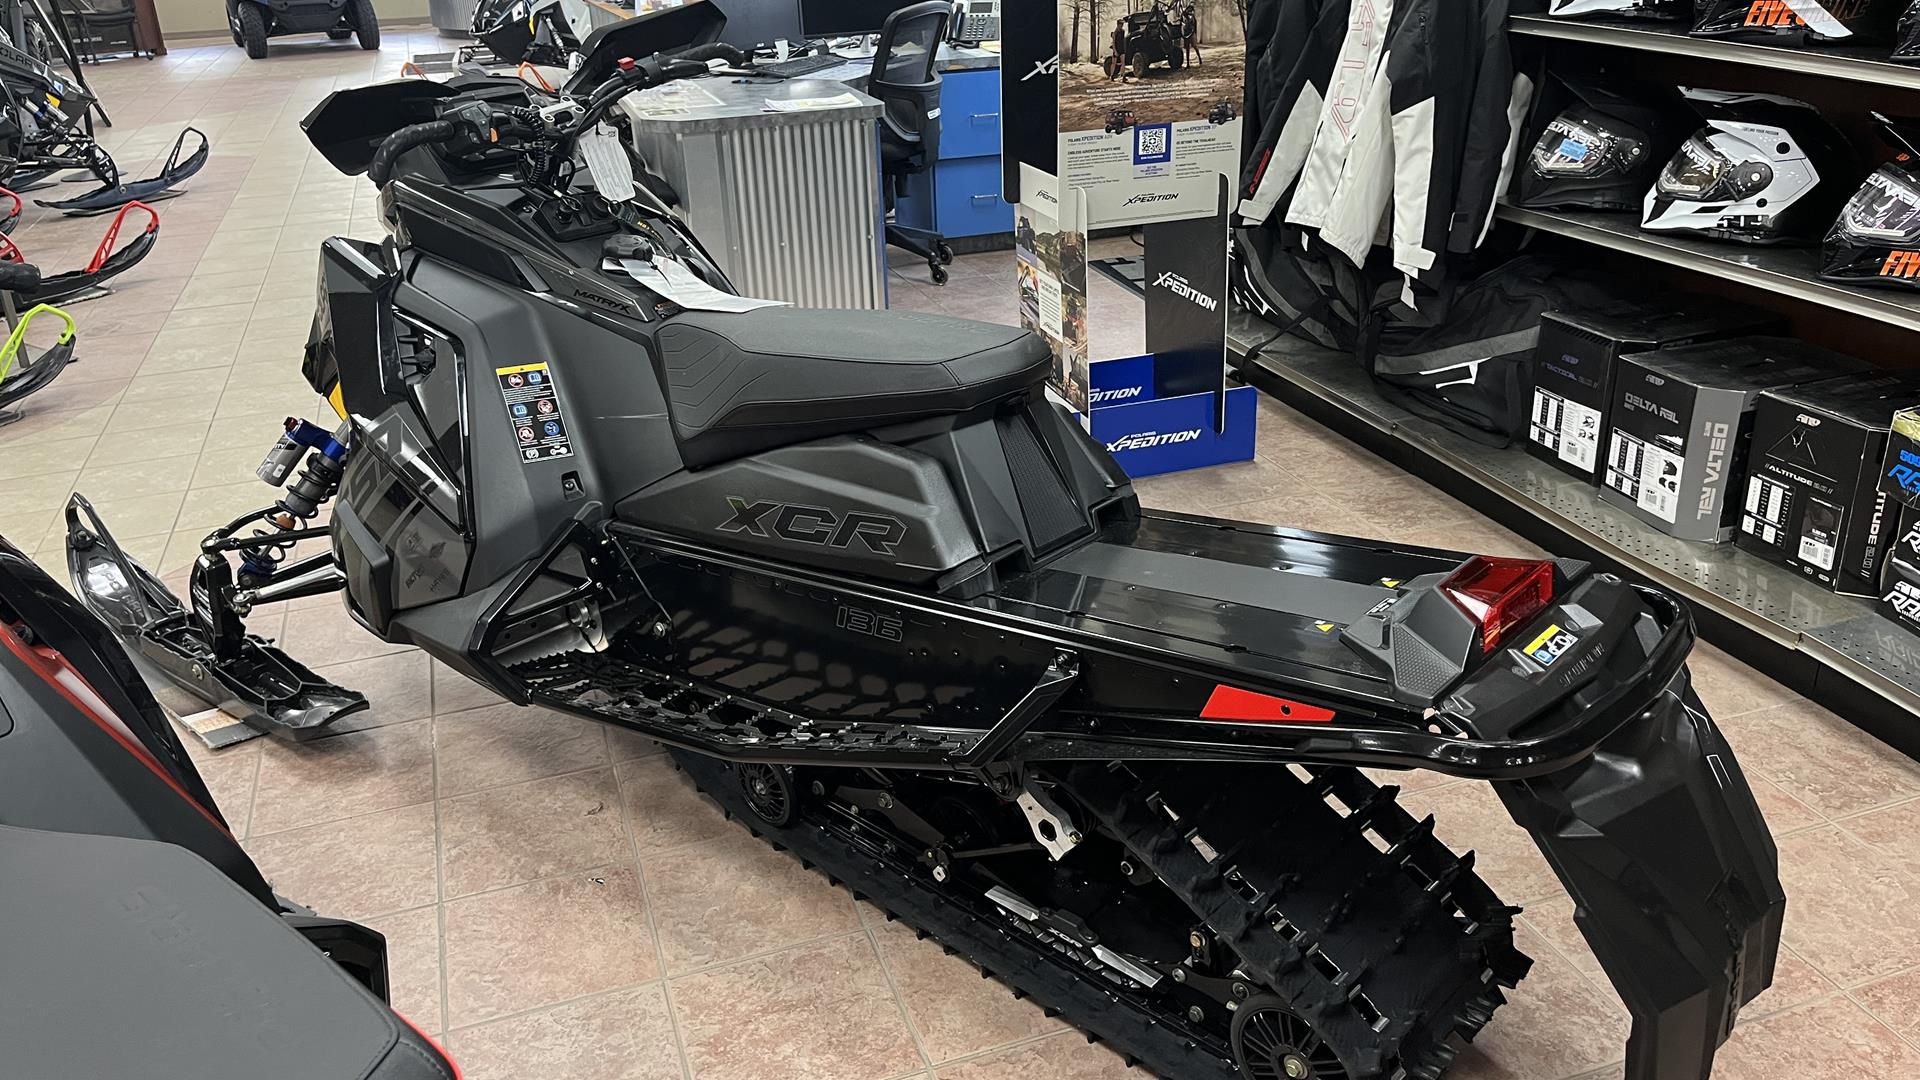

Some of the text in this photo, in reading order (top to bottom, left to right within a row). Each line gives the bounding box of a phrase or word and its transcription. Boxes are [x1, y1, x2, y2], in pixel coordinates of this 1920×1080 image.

[573, 289, 632, 315] MATRYX
[1151, 271, 1218, 312] XPEDITION
[1624, 391, 1659, 415] DELTA
[1106, 428, 1202, 453] XPEDITION
[715, 495, 908, 557] XCR
[835, 605, 904, 642] 136
